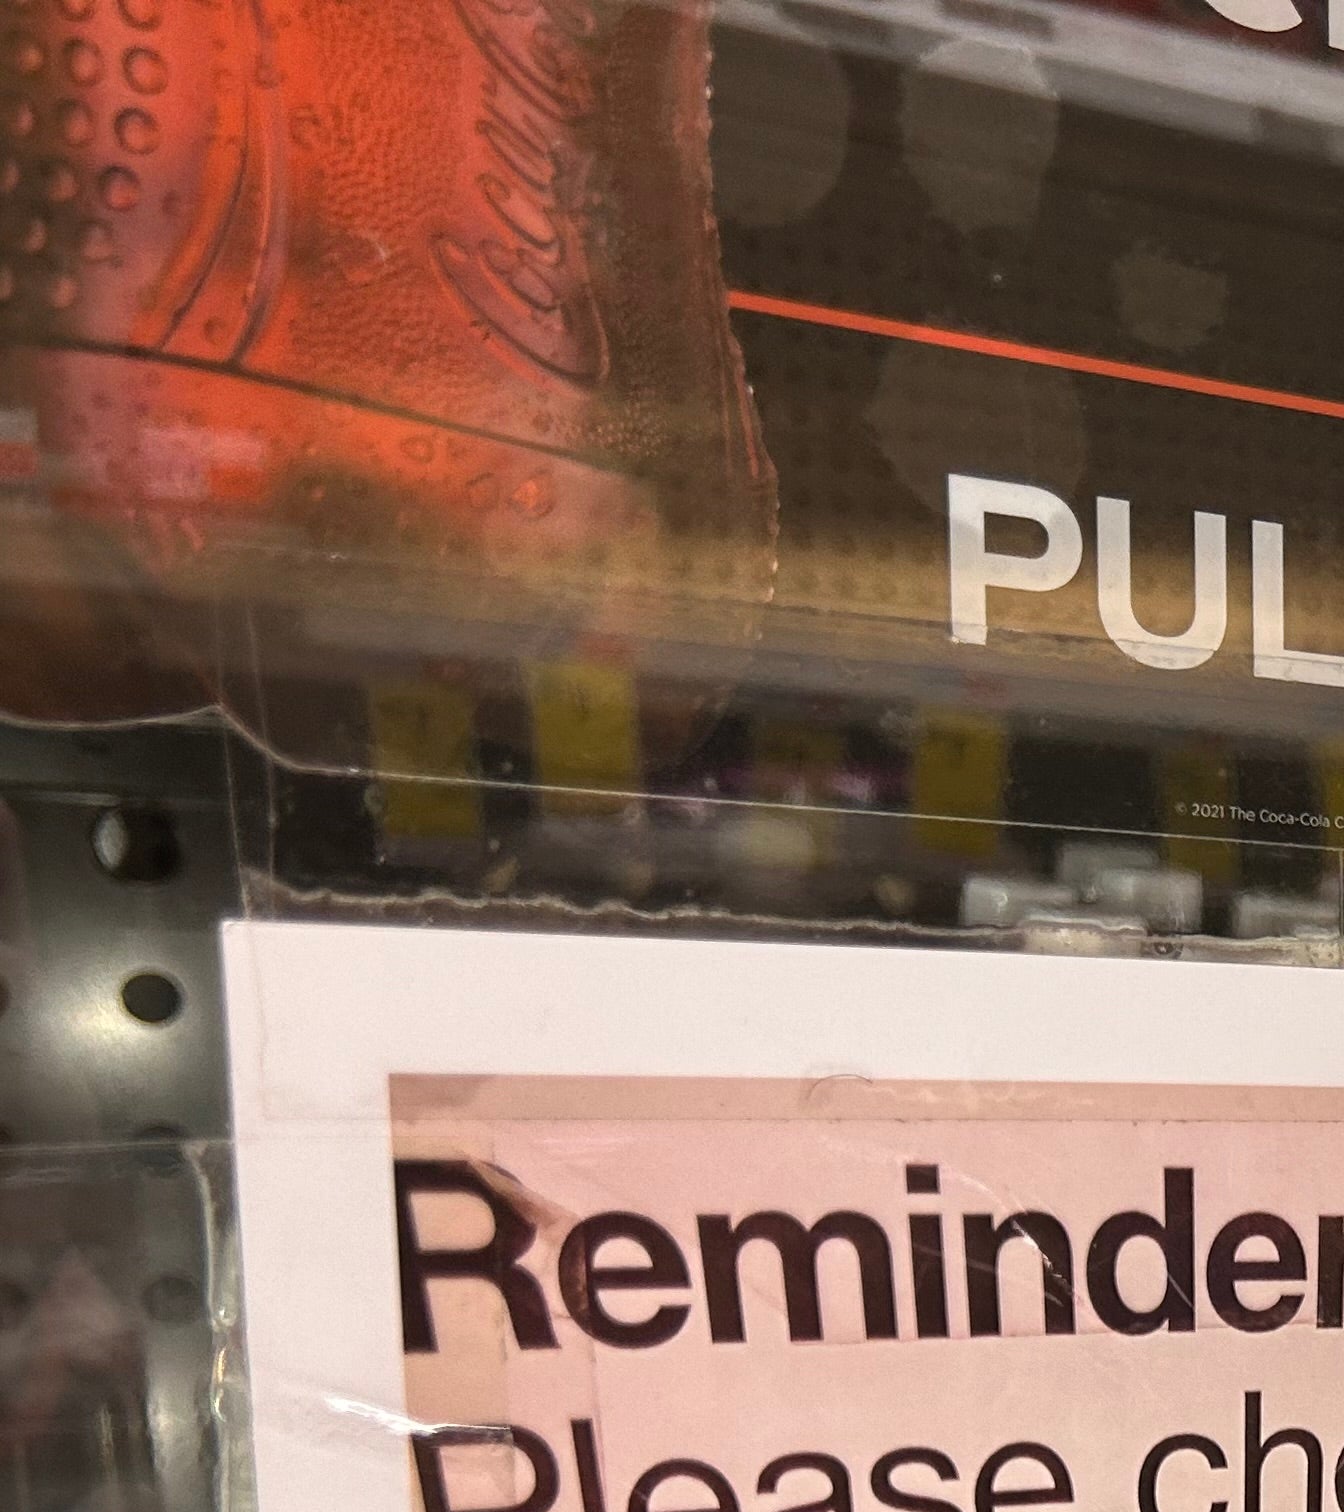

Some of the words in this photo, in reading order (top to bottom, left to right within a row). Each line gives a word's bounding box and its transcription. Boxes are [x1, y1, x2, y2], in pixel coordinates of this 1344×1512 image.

[1191, 803, 1225, 819] 2021
[1229, 806, 1256, 822] The
[1259, 809, 1331, 828] Coca-Cola
